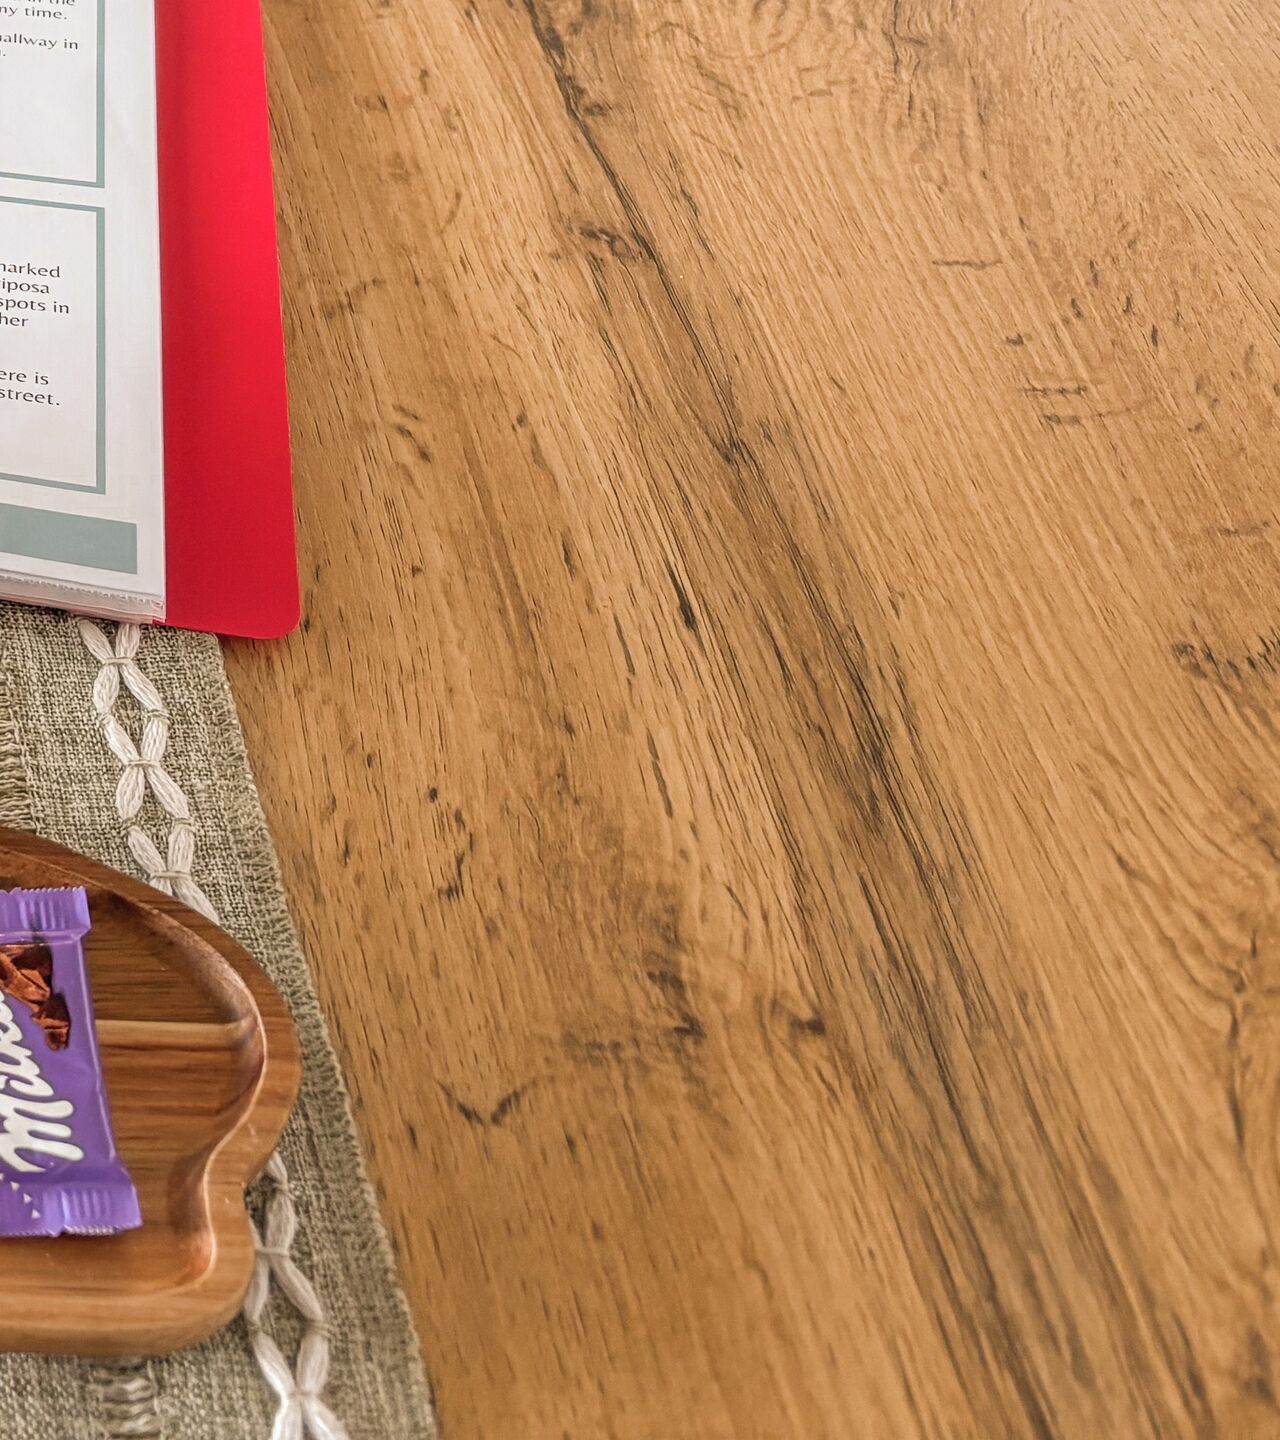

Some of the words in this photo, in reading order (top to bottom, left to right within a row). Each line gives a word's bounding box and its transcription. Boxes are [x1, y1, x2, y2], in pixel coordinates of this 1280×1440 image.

[24, 7, 68, 20] time.
[52, 300, 70, 315] in
[34, 371, 50, 386] is
